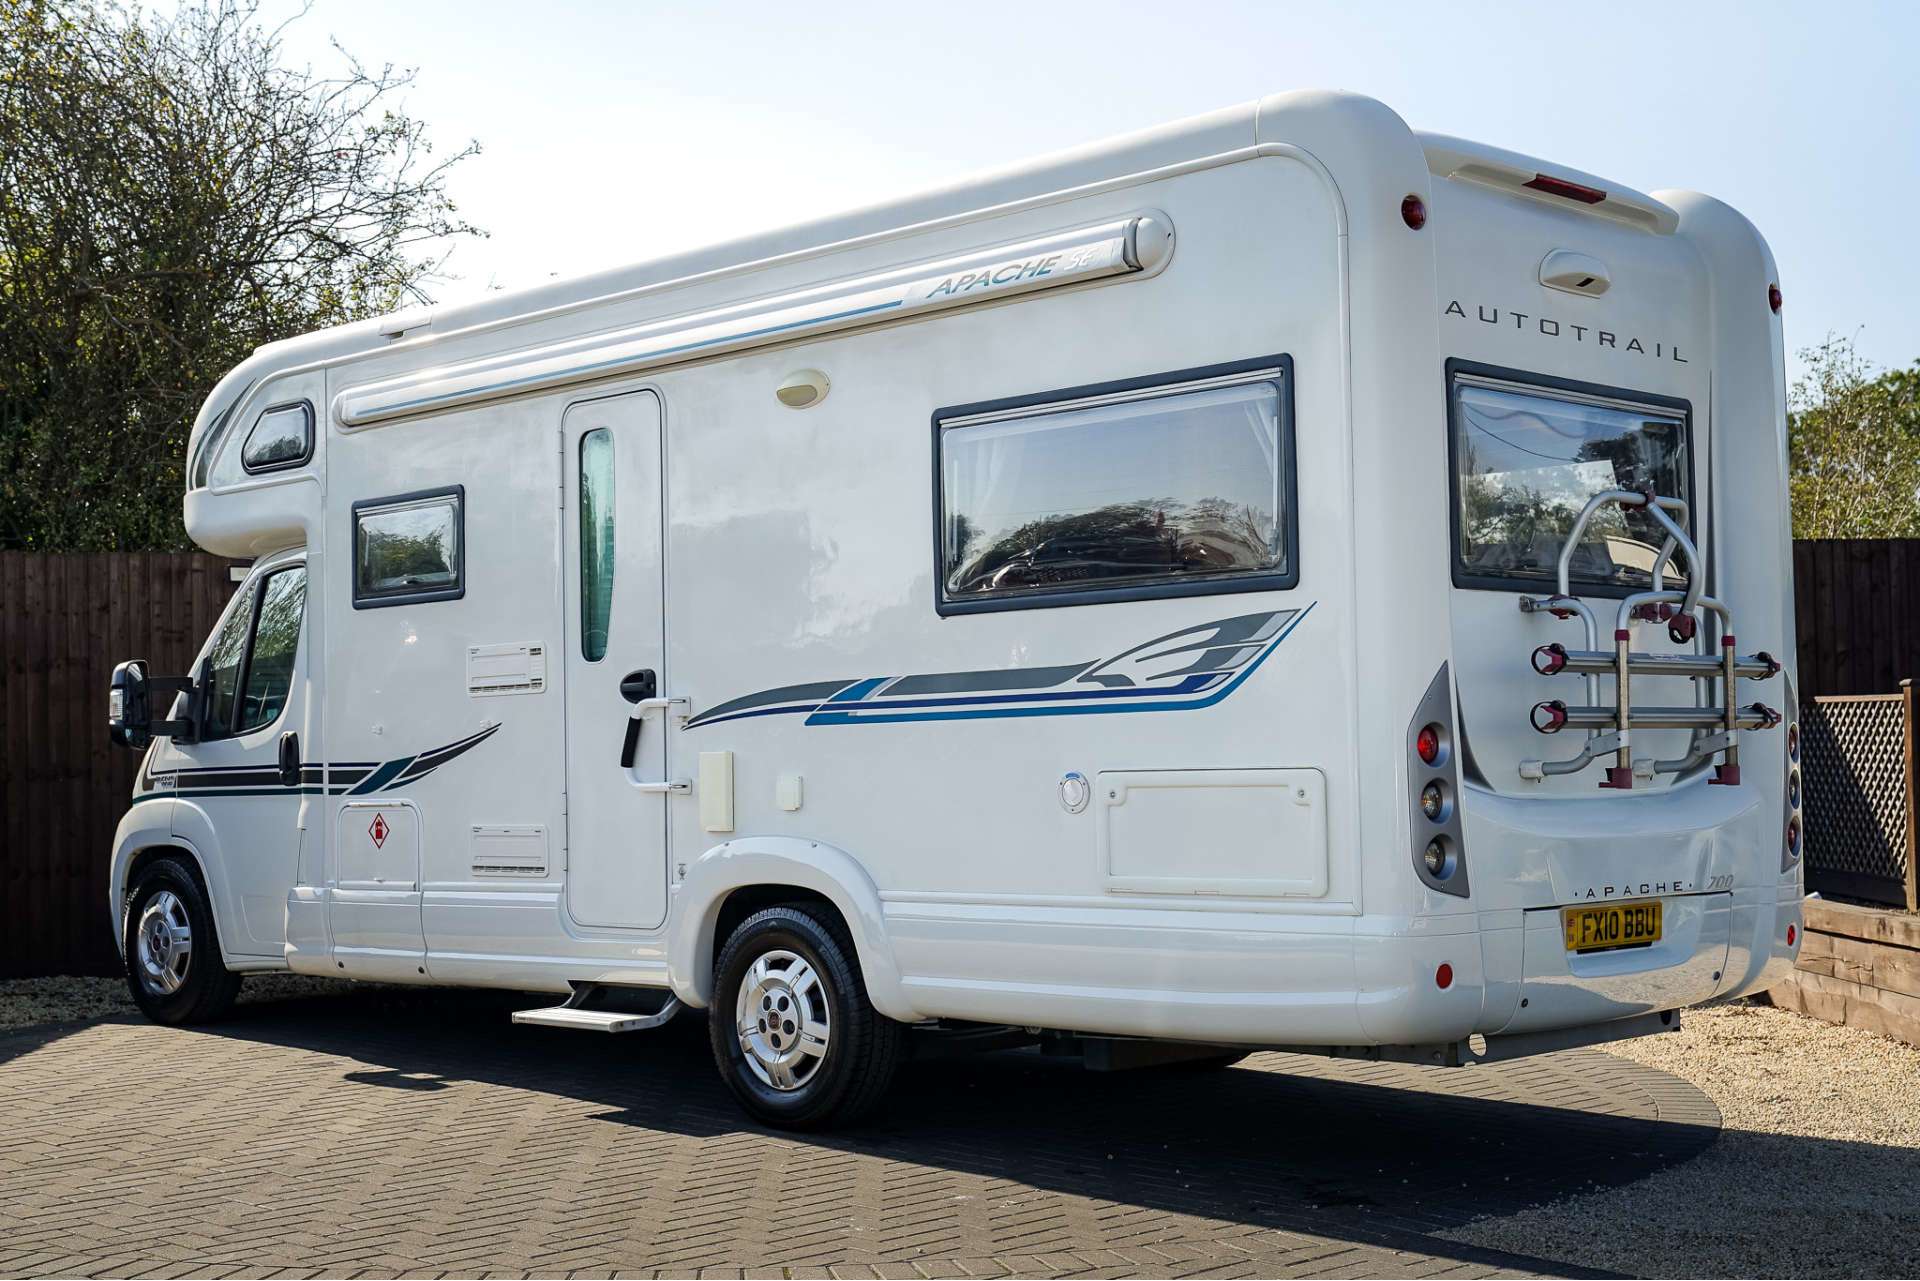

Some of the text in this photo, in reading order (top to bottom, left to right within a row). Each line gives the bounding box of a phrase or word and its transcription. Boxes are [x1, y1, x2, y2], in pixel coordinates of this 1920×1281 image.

[926, 254, 1063, 299] APACHE
[1444, 300, 1688, 363] AUTOTRAIL
[1706, 874, 1734, 889] 700
[1581, 907, 1656, 944] FX10 BBU
